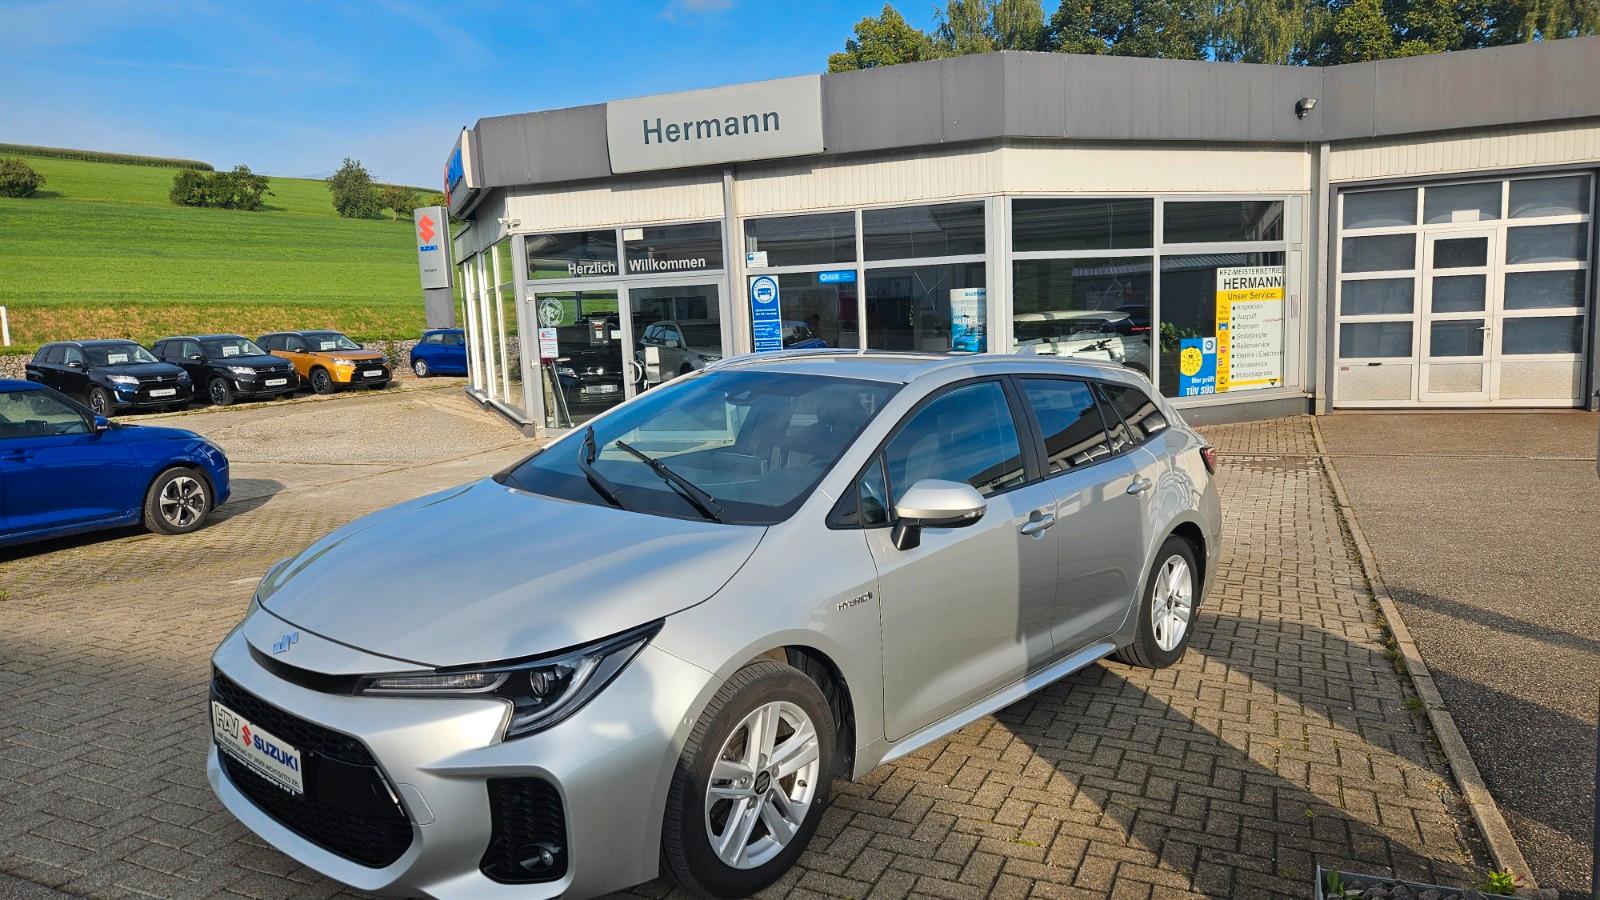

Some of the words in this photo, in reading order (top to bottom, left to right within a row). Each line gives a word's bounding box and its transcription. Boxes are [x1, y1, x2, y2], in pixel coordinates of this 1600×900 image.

[643, 111, 780, 145] Hermann
[567, 261, 616, 275] Herzlich
[629, 257, 706, 272] Willkommen
[1223, 276, 1282, 290] HERMANN
[1227, 293, 1248, 301] Unser
[1185, 385, 1200, 396] TÜV
[1200, 384, 1214, 395] SÜD
[253, 734, 299, 772] SUZUKI
